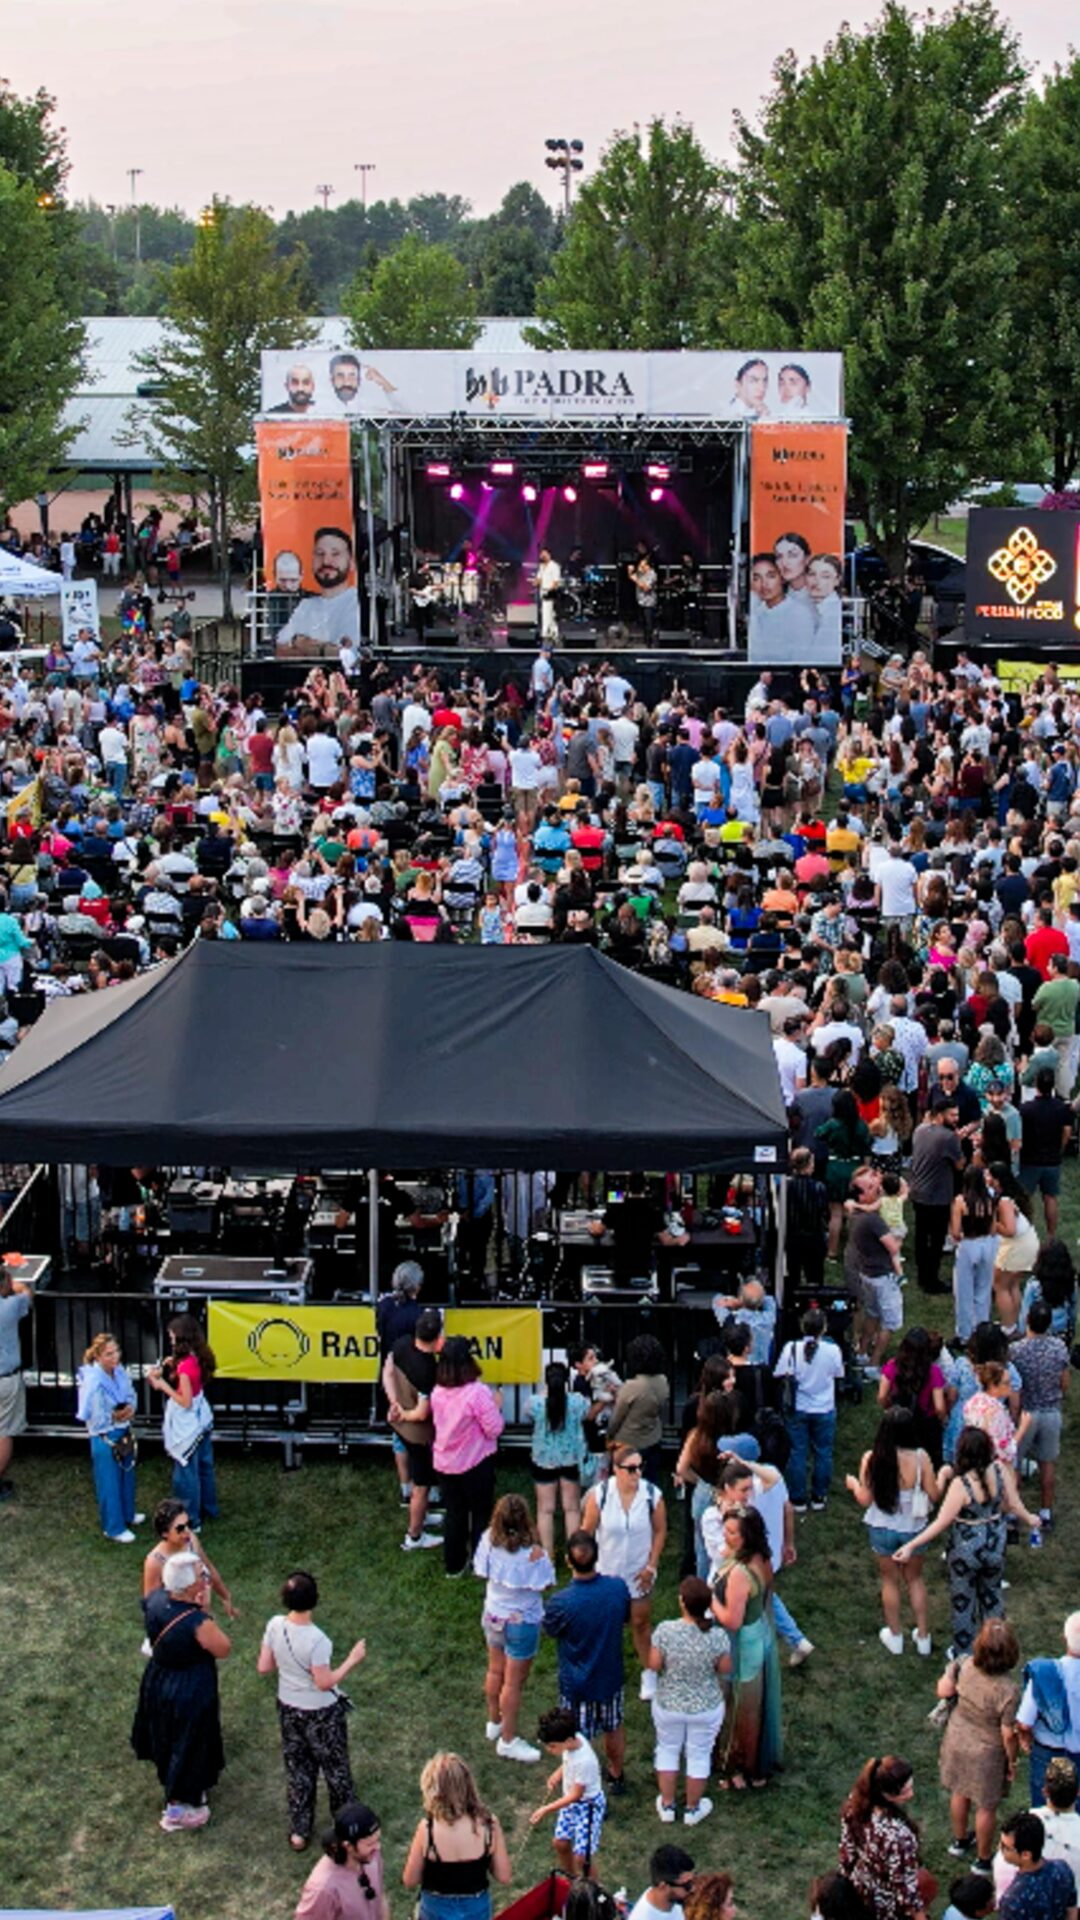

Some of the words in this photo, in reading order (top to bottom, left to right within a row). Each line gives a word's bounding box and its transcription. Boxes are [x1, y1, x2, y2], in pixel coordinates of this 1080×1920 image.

[514, 369, 634, 396] PADRA
[1026, 606, 1063, 620] FOOD
[321, 1331, 379, 1357] RAD
